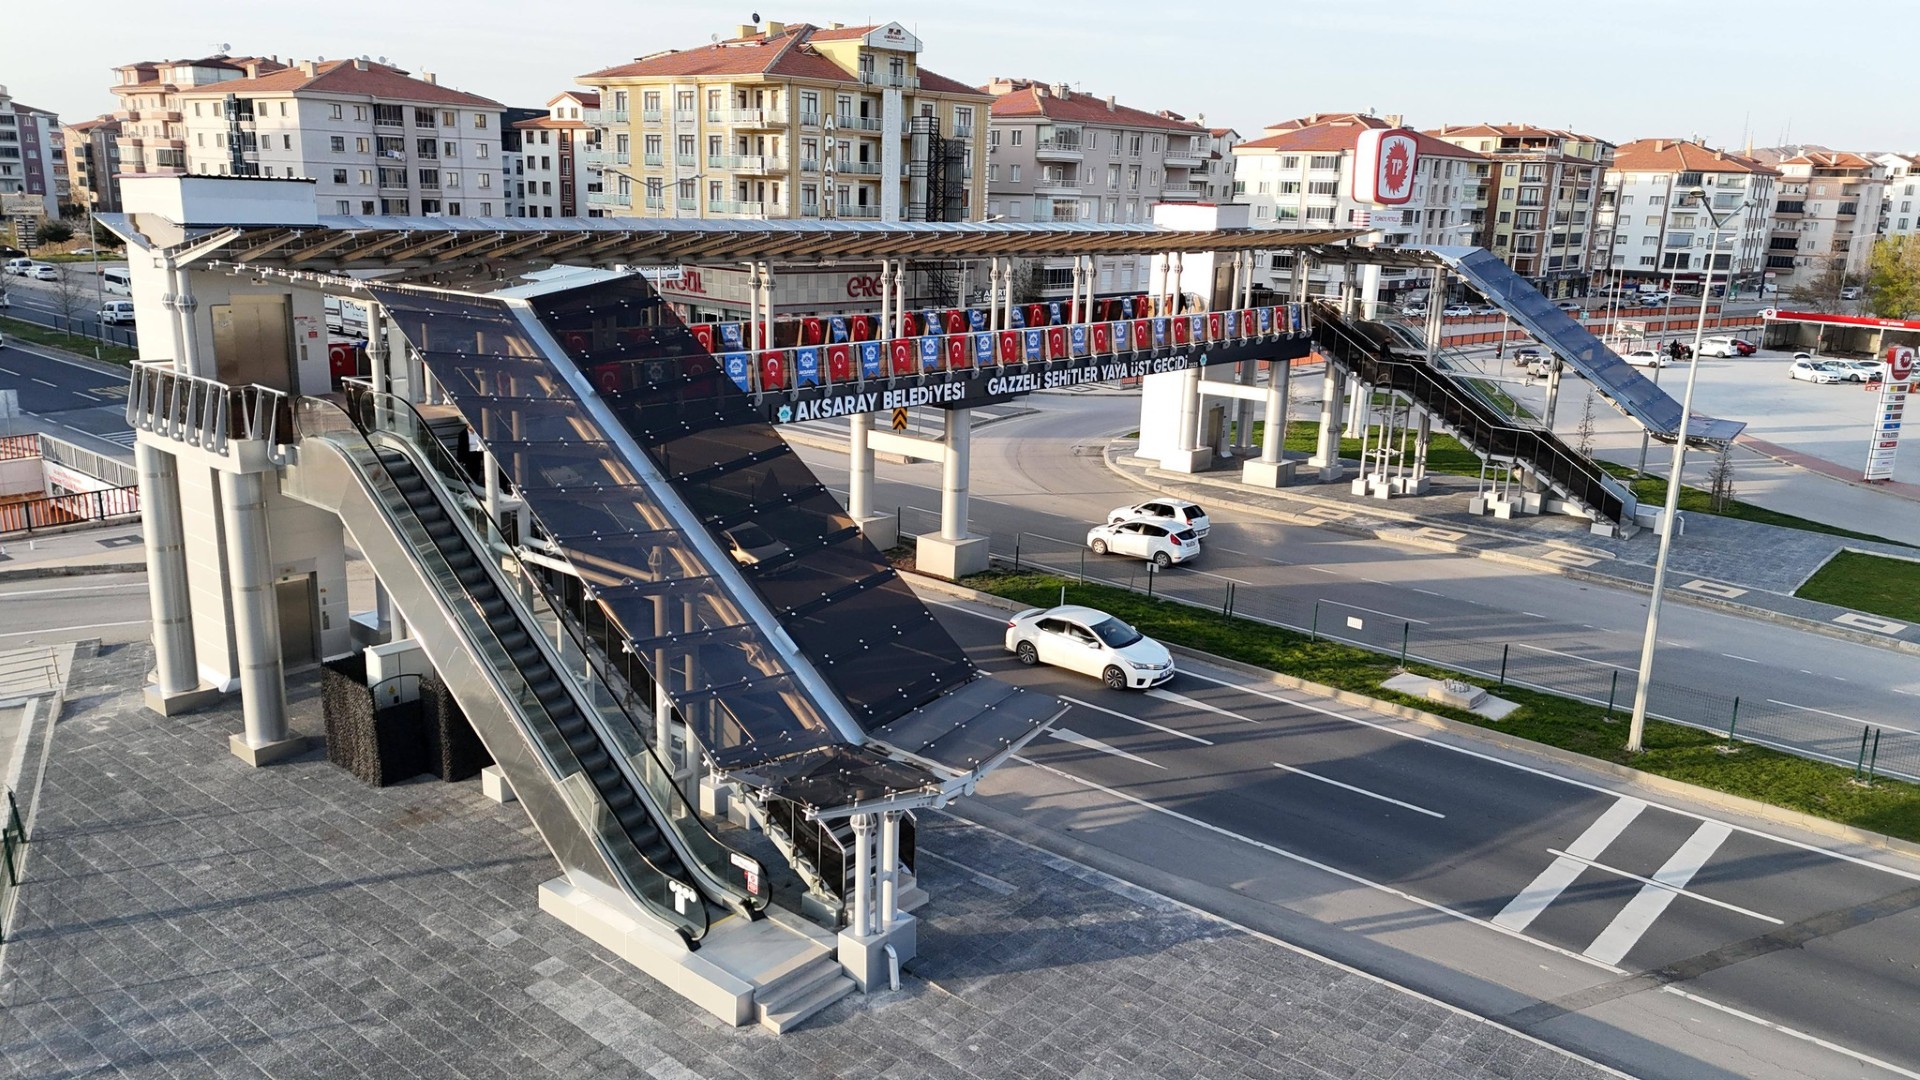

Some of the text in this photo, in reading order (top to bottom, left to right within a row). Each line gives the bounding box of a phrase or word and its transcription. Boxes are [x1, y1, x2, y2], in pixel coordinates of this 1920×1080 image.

[824, 114, 835, 211] APART
[1391, 158, 1403, 176] TP
[1100, 361, 1128, 380] YAYA
[1130, 359, 1152, 377] ÜST
[794, 392, 879, 422] AKSARAY
